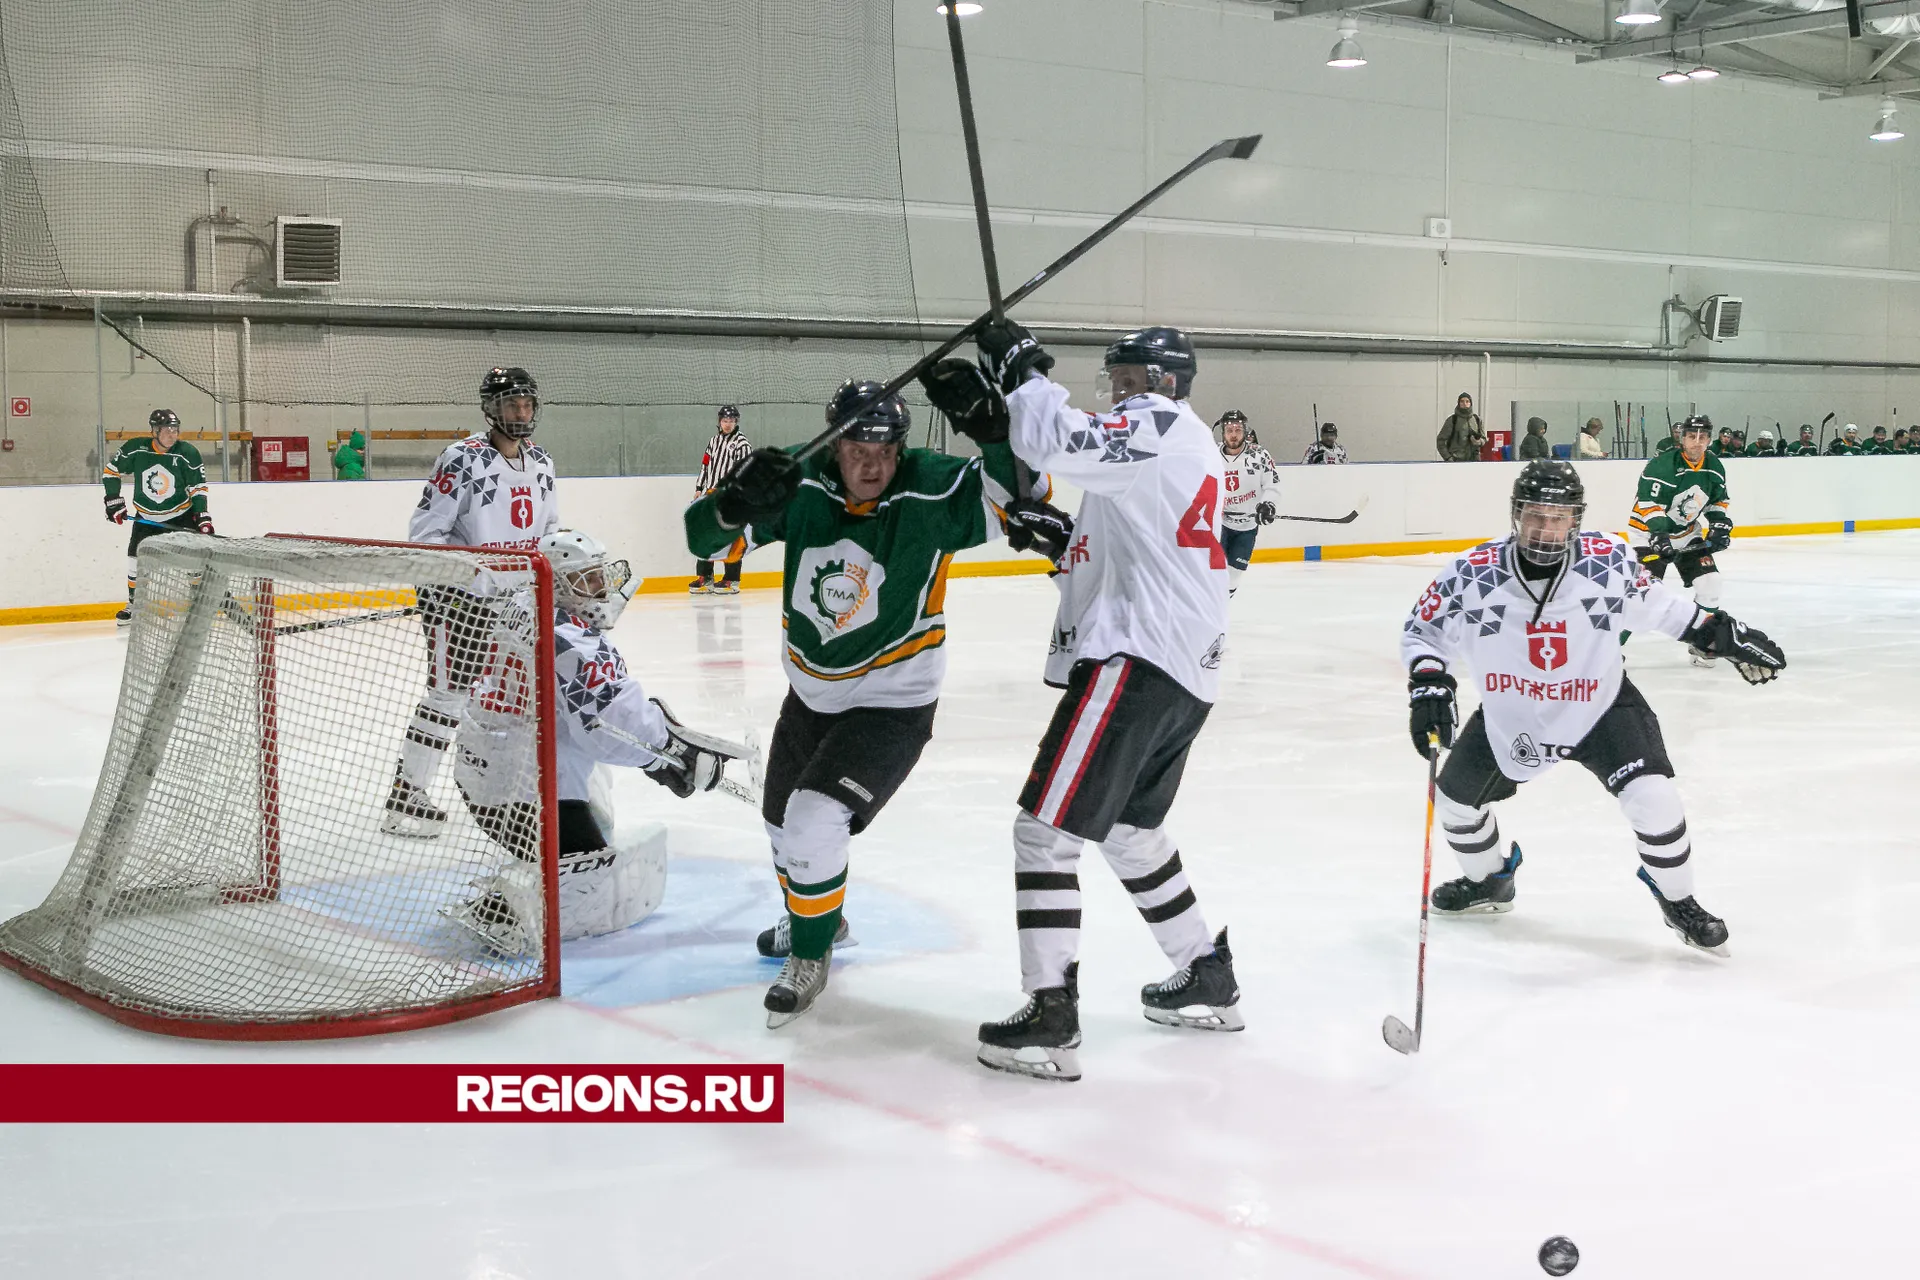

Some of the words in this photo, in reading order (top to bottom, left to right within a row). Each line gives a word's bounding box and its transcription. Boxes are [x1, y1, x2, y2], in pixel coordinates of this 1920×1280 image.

[1650, 481, 1662, 498] 9
[1175, 473, 1227, 570] 4
[1607, 758, 1645, 788] CCM
